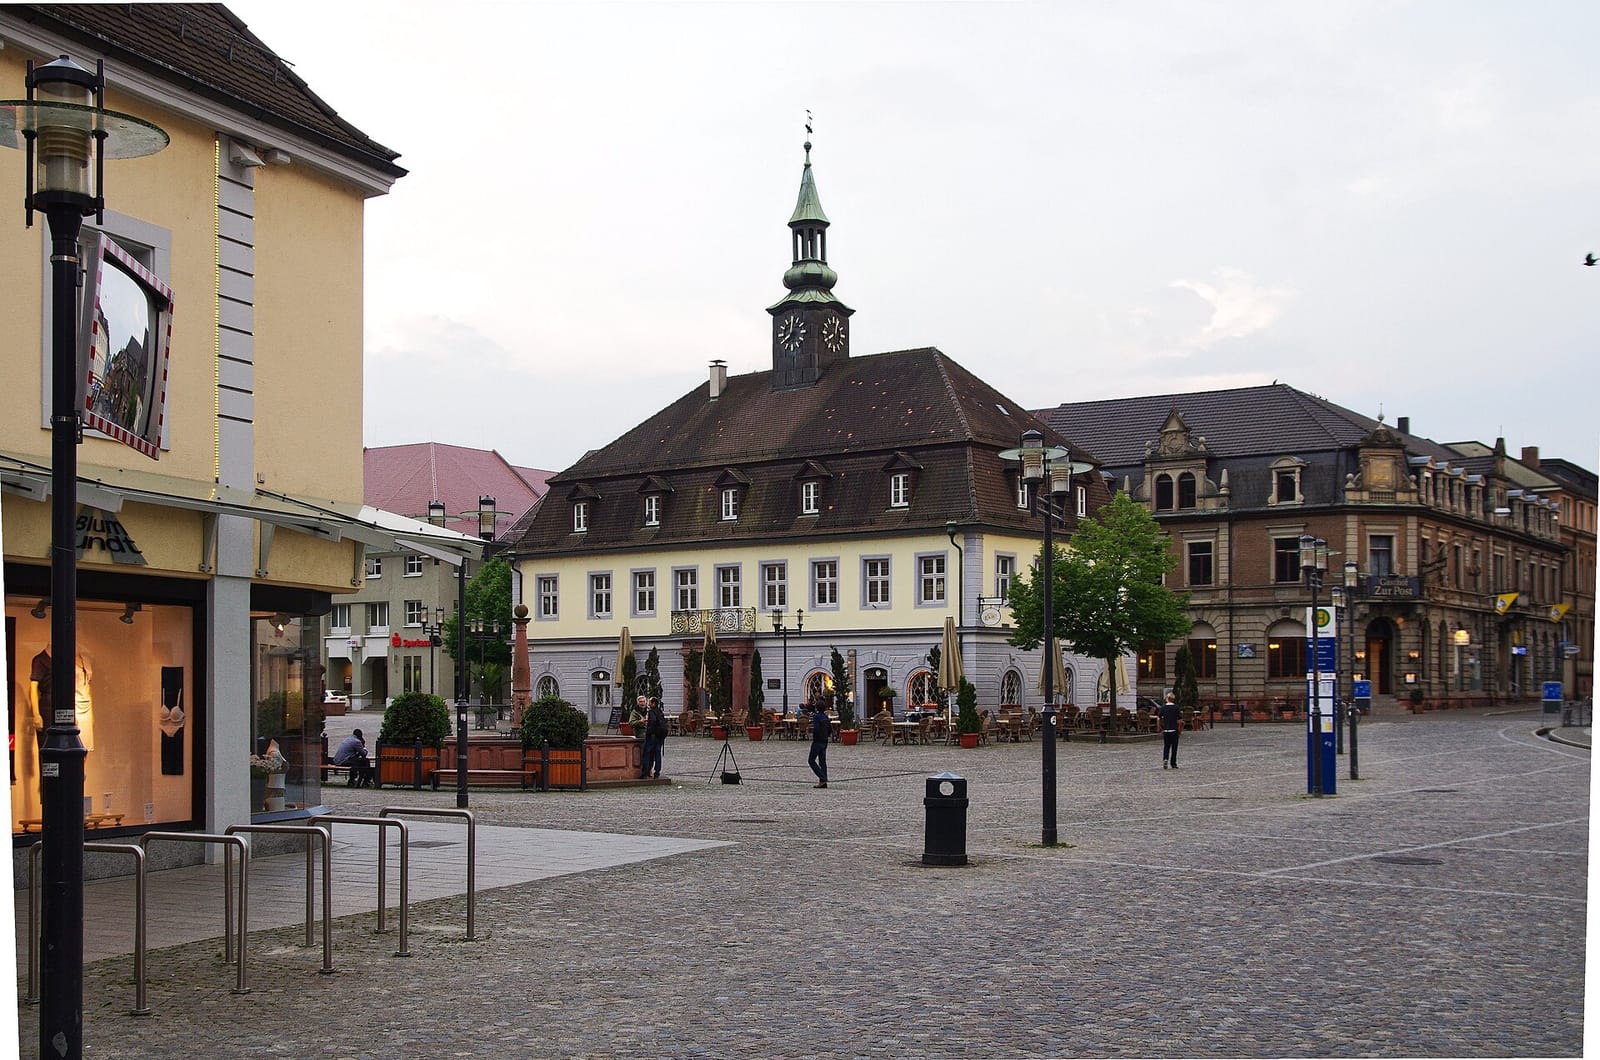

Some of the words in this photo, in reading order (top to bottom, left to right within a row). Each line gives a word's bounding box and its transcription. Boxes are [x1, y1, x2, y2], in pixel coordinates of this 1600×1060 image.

[76, 516, 128, 535] Blum
[1374, 586, 1392, 595] Zur
[1394, 586, 1413, 596] Post
